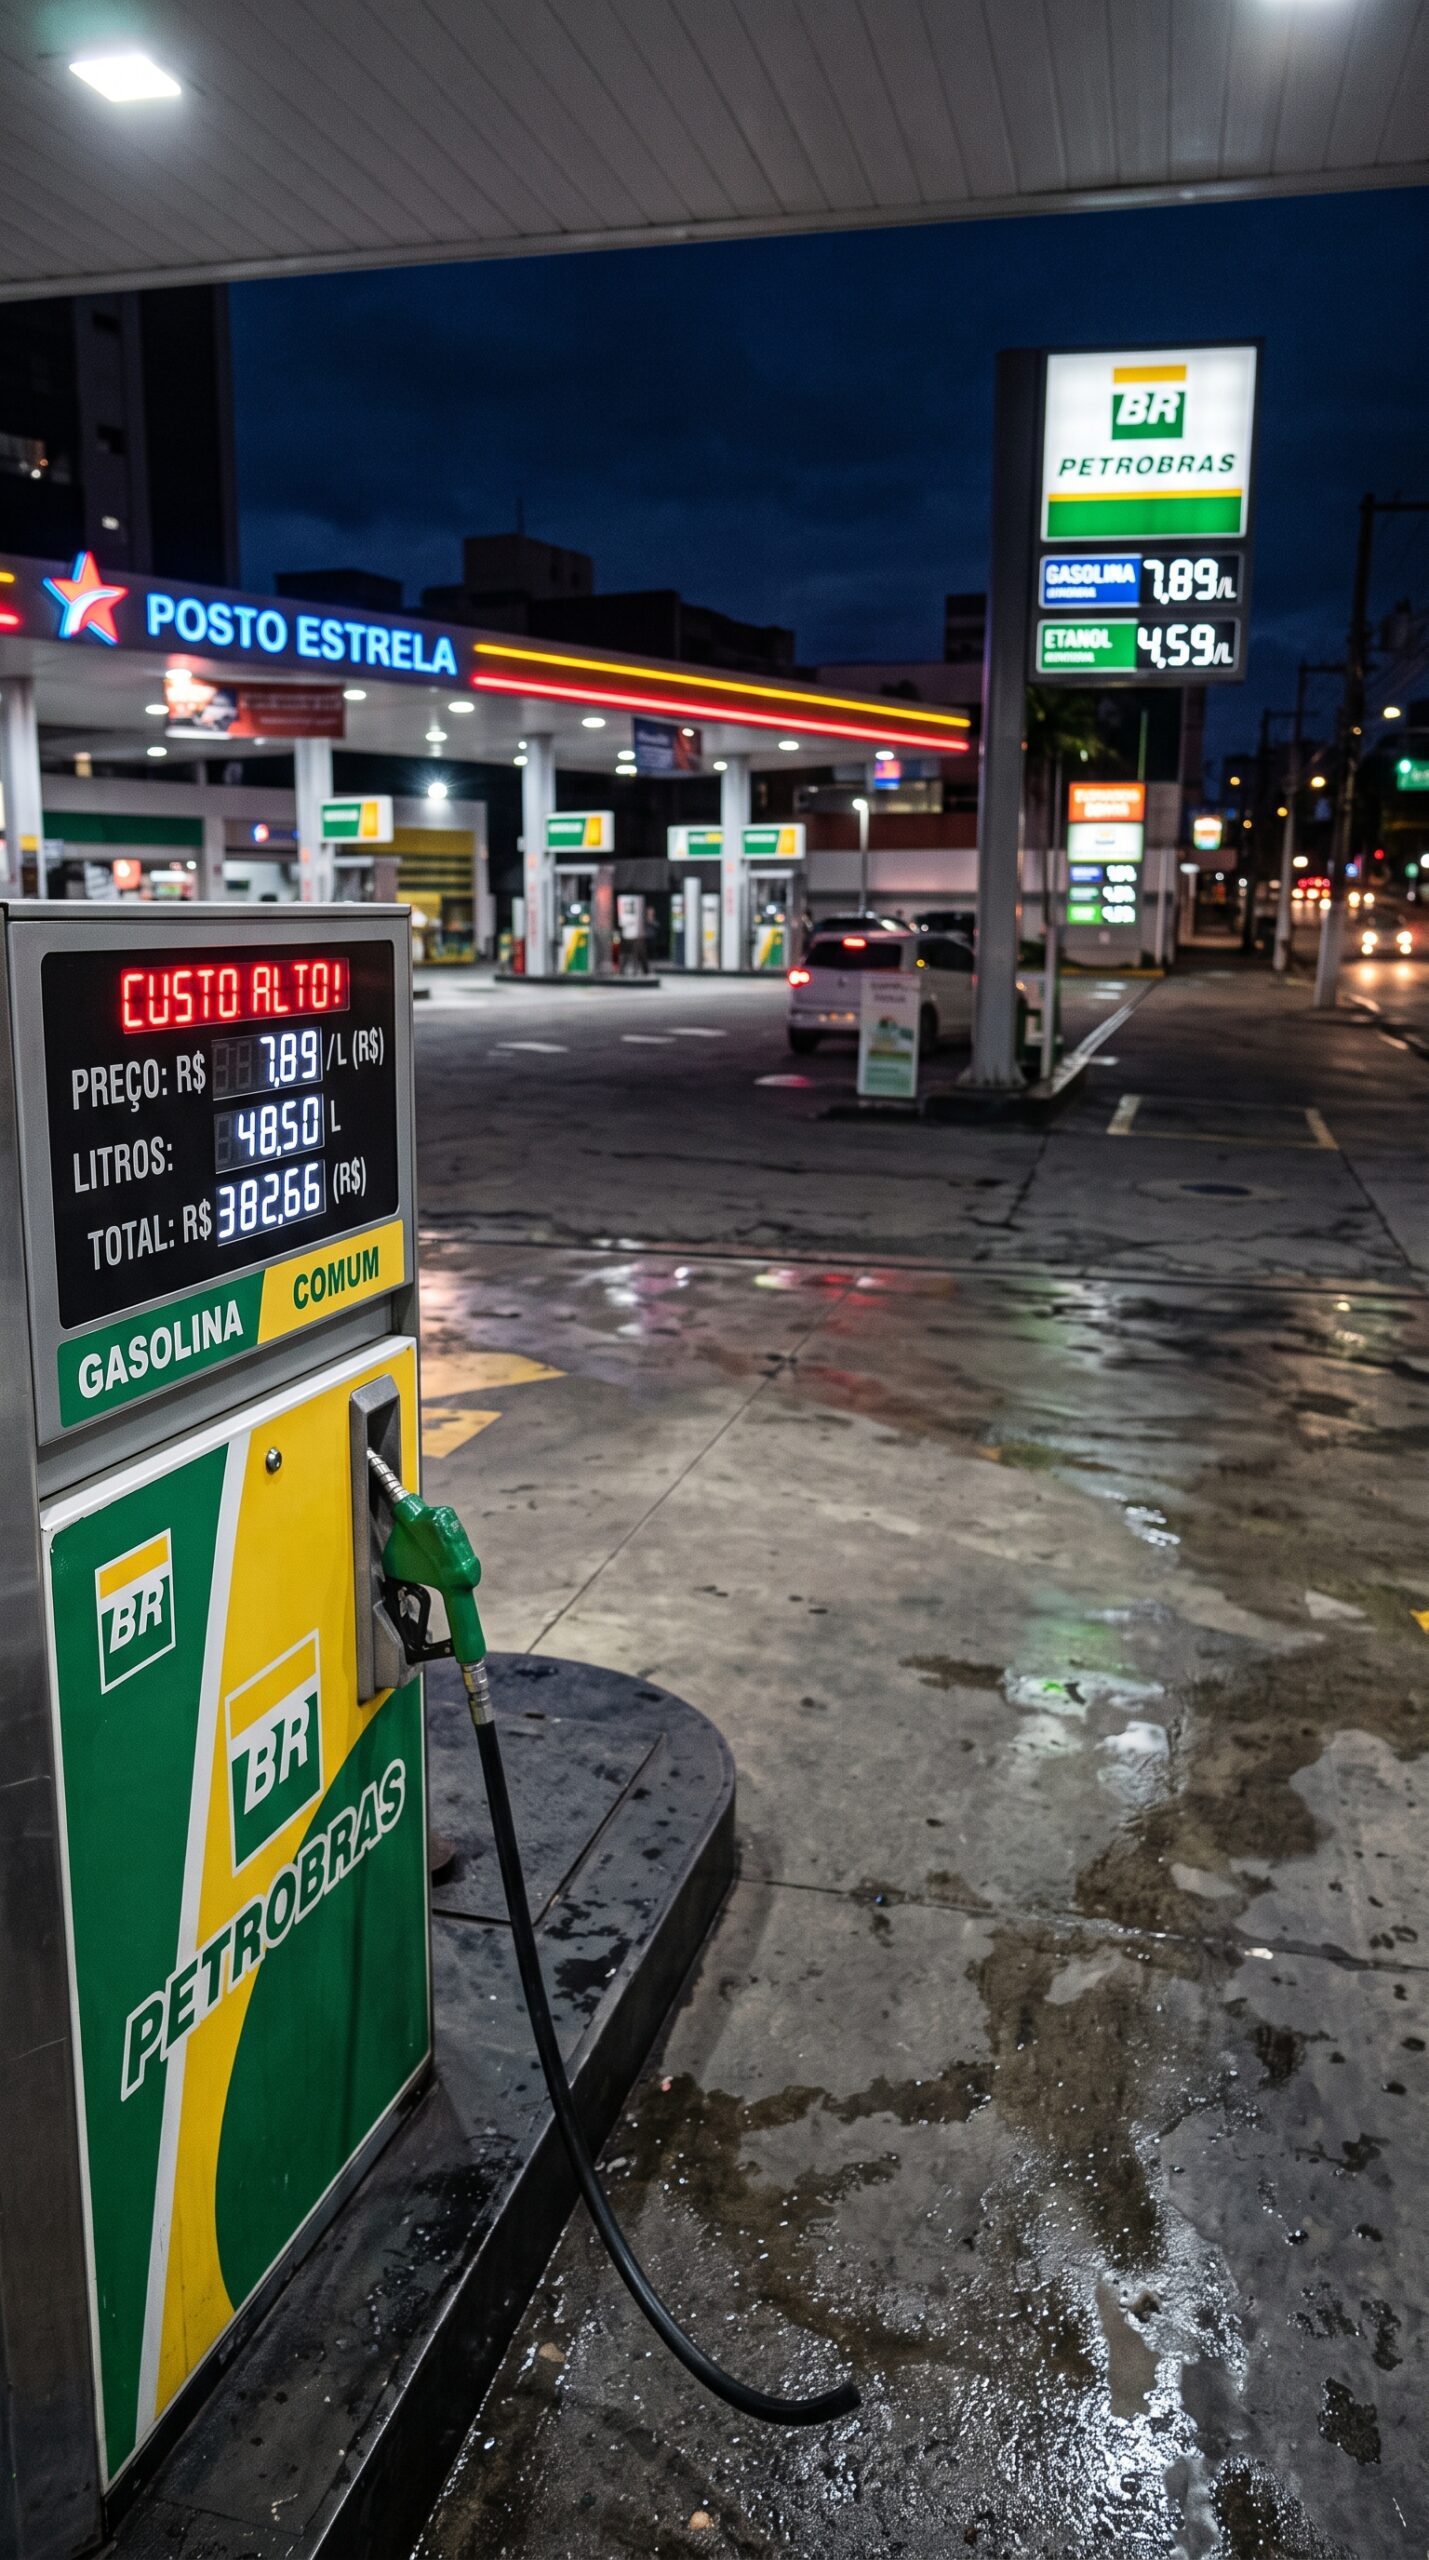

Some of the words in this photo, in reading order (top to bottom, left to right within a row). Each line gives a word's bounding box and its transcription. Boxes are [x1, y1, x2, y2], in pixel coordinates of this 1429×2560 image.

[1115, 391, 1181, 426] BR
[1058, 453, 1236, 477] PETROBRAS
[1046, 563, 1136, 584] GASOLINA
[147, 594, 287, 653] POSTO
[297, 615, 457, 676] ESTRELA
[1044, 628, 1113, 649] ETANOL
[123, 968, 237, 1027] CUSTO
[253, 963, 340, 1013] ALTO!
[72, 1059, 168, 1112] PREÇO:
[176, 1050, 206, 1094] R$
[260, 1030, 317, 1088] 7,89
[352, 1027, 384, 1070] (R$)
[73, 1136, 173, 1193] LITROS:
[238, 1097, 319, 1157] 48,50
[331, 1100, 341, 1132] L
[87, 1214, 175, 1271] TOTAL:
[182, 1198, 212, 1241] R$
[219, 1163, 320, 1238] 382,66
[333, 1157, 366, 1204] (R$)
[78, 1300, 243, 1399] GASOLINA
[293, 1246, 379, 1310] COMUM
[108, 1578, 165, 1655] BR
[243, 1700, 312, 1816] BR
[121, 1758, 406, 2102] PETROBRAS
